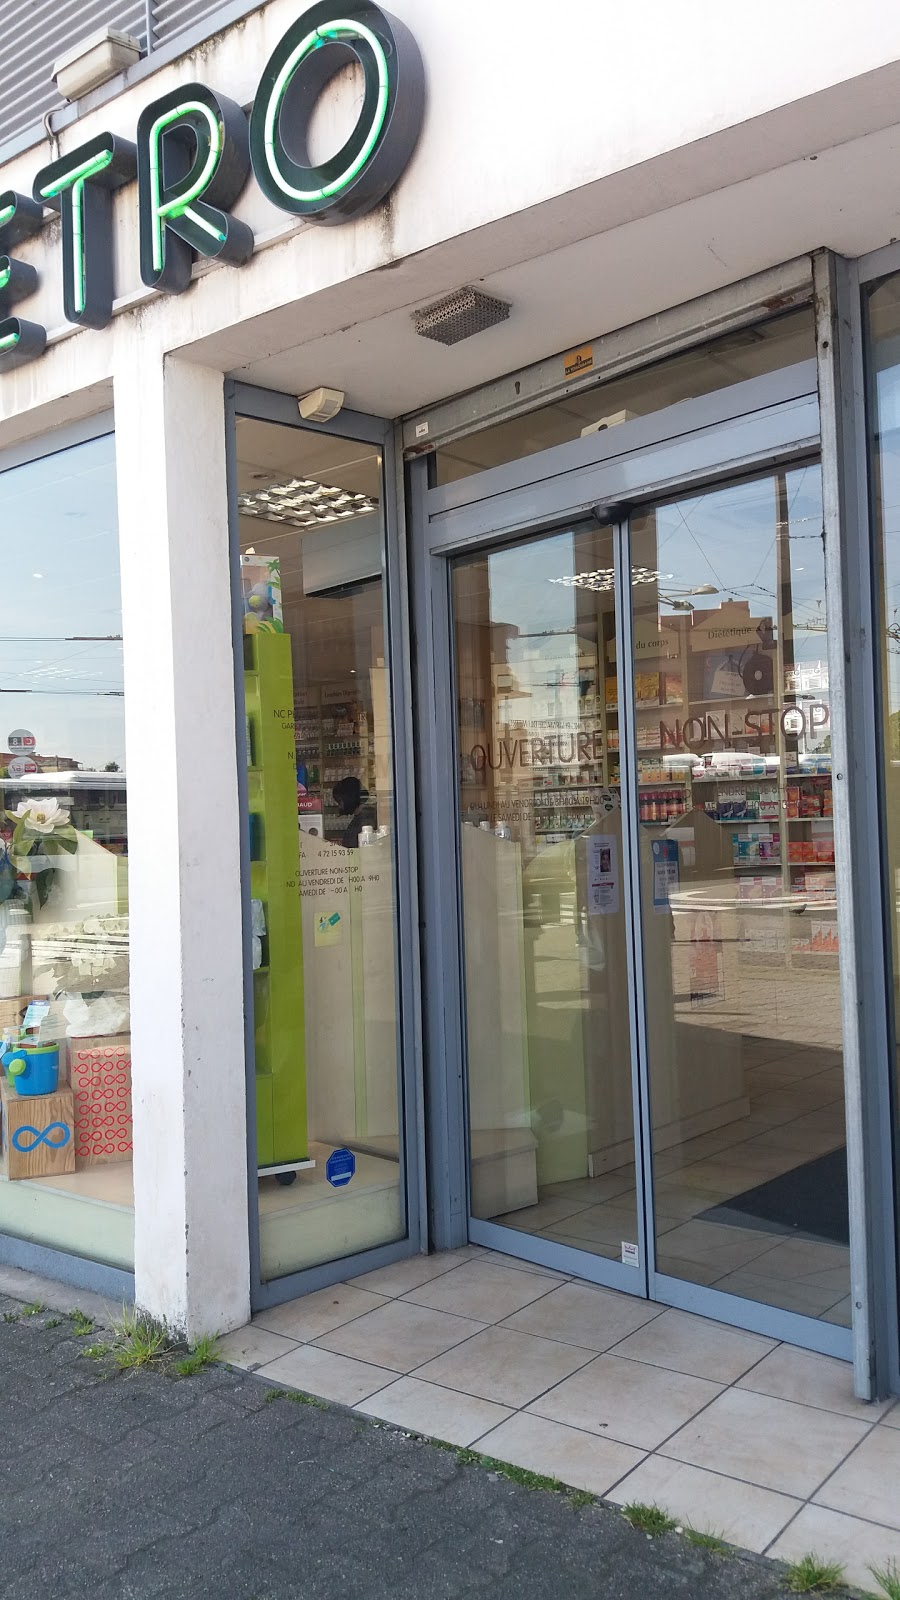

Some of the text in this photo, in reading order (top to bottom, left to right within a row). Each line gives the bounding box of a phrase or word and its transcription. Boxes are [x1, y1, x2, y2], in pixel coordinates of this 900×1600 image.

[707, 625, 752, 641] Diététique
[635, 637, 669, 652] du corps
[659, 703, 830, 752] NON-STOP
[470, 729, 605, 772] OUVERTURE
[295, 866, 359, 877] OUVERTURE NON-STOP
[308, 877, 336, 887] VENDREDI
[336, 877, 344, 885] DE
[318, 888, 326, 896] DE
